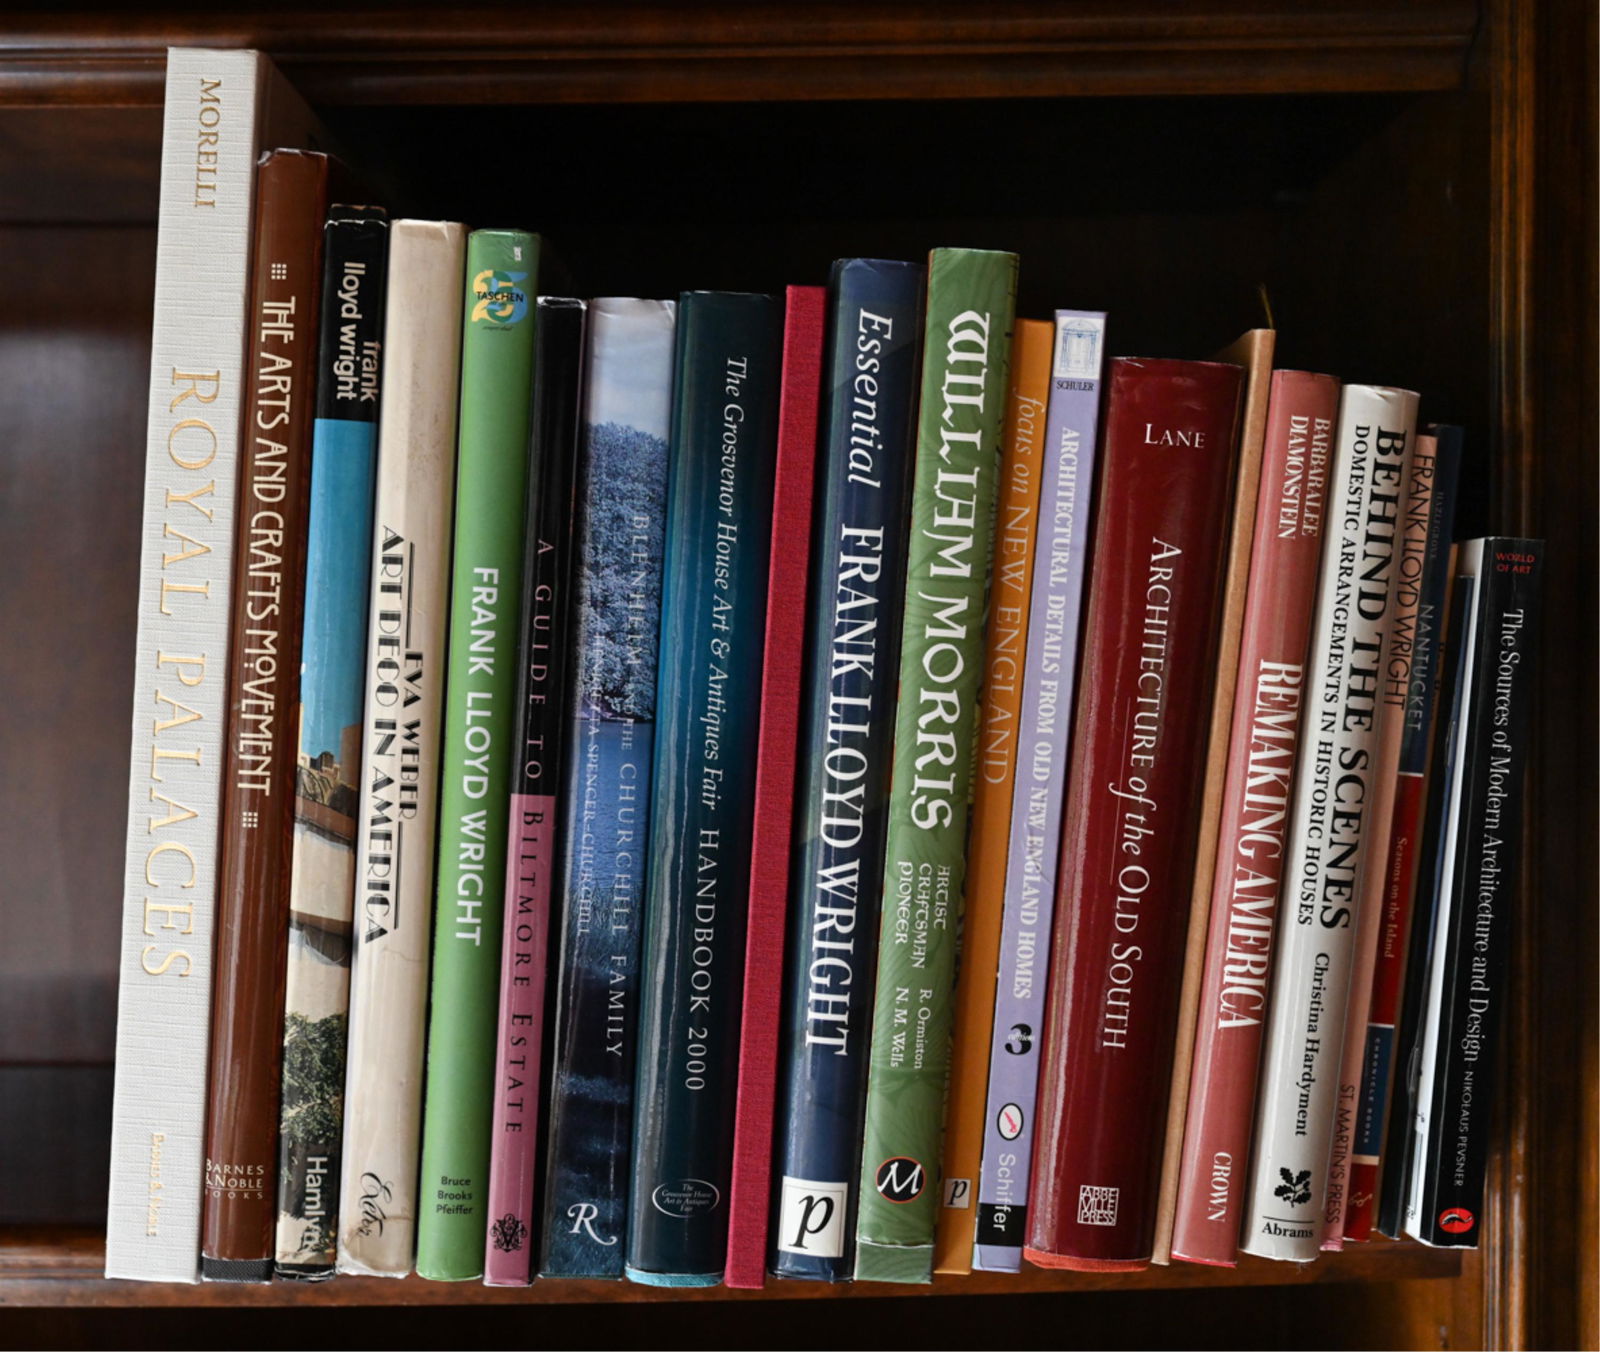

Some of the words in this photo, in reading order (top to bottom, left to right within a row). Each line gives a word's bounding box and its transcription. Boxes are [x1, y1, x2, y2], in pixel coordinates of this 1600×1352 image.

[193, 78, 222, 208] MORELLI
[260, 296, 296, 344] THE
[338, 260, 366, 320] lloyd
[477, 291, 524, 302] TASCHEN
[256, 353, 294, 426] ARTS
[333, 323, 361, 401] wright
[359, 340, 380, 402] frank
[725, 357, 747, 397] The
[848, 308, 892, 488] Essential
[1056, 380, 1095, 391] SCHULER
[719, 403, 745, 517] Grosvenor
[921, 310, 990, 578] WILLIAM
[1015, 391, 1045, 456] focus
[1144, 423, 1205, 449] LANE
[159, 366, 221, 616] ROYAL
[253, 438, 289, 503] AND
[1012, 463, 1030, 494] on
[1049, 427, 1080, 588] ARCHITECTURAL
[1278, 416, 1309, 539] DIAMONSTEIN
[1302, 418, 1330, 536] BARBARALEE
[1344, 425, 1370, 531] DOMESTIC
[1405, 454, 1435, 533] FRANK
[538, 539, 554, 554] A
[714, 521, 738, 590] House
[1001, 505, 1030, 592] NEW
[1357, 425, 1407, 622] BEHIND
[1495, 552, 1535, 564] WORLD
[247, 507, 284, 622] CRAFTS
[381, 525, 404, 600] ART
[627, 515, 650, 665] BLENHEIM
[1397, 537, 1424, 608] LLOYD
[1496, 563, 1510, 573] OF
[1512, 565, 1532, 575] ART
[468, 567, 499, 676] FRANK
[711, 594, 733, 632] Art
[831, 523, 884, 680] FRANK
[1041, 594, 1067, 674] DETAILS
[1324, 537, 1356, 704] ARRANGEMENTS
[1501, 609, 1524, 647] The
[375, 609, 401, 708] DECO
[403, 651, 423, 709] EVA
[529, 584, 553, 704] GUIDE
[710, 637, 731, 659] &
[1130, 536, 1182, 768] ARCHITECTURE
[1384, 614, 1417, 711] WRIGHT
[1407, 604, 1434, 731] NANTUCKET
[236, 623, 280, 796] MOVEMENT
[700, 663, 729, 760] Antiques
[911, 591, 969, 830] MORRIS
[983, 606, 1021, 784] ENGLAND
[1036, 679, 1058, 735] FROM
[1342, 632, 1383, 732] THE
[1493, 650, 1521, 726] Sources
[372, 718, 397, 757] IN
[462, 691, 493, 800] LLOYD
[525, 734, 543, 779] TO
[1237, 658, 1302, 860] REMAKING
[1320, 711, 1337, 734] IN
[1492, 731, 1513, 752] of
[398, 718, 421, 820] WEBER
[702, 765, 724, 810] Fair
[820, 692, 872, 848] LLOYD
[1032, 741, 1052, 782] OLD
[1108, 776, 1157, 811] of
[1308, 740, 1333, 839] HISTORIC
[1485, 755, 1511, 829] Modern
[141, 652, 208, 978] PALACES
[577, 744, 599, 937] SPENCER-CHURCHILL
[1028, 787, 1049, 830] NEW
[1122, 813, 1154, 856] the
[1320, 746, 1369, 930] SCENES
[365, 766, 394, 944] AMERICA
[455, 808, 488, 947] WRIGHT
[612, 763, 637, 936] CHURCHILL
[1020, 835, 1045, 926] ENGLAND
[1298, 847, 1320, 926] HOUSES
[513, 809, 544, 988] BILTMORE
[688, 828, 720, 1013] HANDBOOK
[895, 860, 913, 945] PIONEER
[912, 862, 932, 969] CRAFTSMAN
[1114, 864, 1150, 934] OLD
[1388, 902, 1400, 920] the
[1391, 884, 1400, 899] on
[1474, 834, 1504, 952] Architecture
[805, 858, 860, 1056] WRIGHT
[1013, 931, 1036, 999] HOMES
[1218, 863, 1278, 1030] AMERICA
[1470, 957, 1490, 992] and
[605, 955, 628, 1057] FAMILY
[894, 1008, 908, 1027] M.
[896, 986, 909, 1004] N.
[919, 988, 932, 1003] R.
[1103, 943, 1142, 1049] SOUTH
[1307, 952, 1330, 1034] Christina
[1461, 999, 1489, 1062] Design
[505, 1013, 532, 1133] ESTATE
[685, 1026, 709, 1091] 2000
[890, 1031, 906, 1068] Wells
[914, 1007, 931, 1069] Ormiston
[1295, 1037, 1320, 1137] Hardyment
[1340, 1084, 1355, 1104] ST.
[1457, 1070, 1474, 1133] NIKOLAUS
[206, 1158, 265, 1175] BARNES
[215, 1174, 264, 1189] NOBLE
[441, 1176, 471, 1186] Bruce
[1329, 1109, 1351, 1180] MARTIN'S
[1453, 1136, 1468, 1187] PEVSNER
[303, 1156, 328, 1246] Hamlyn
[436, 1204, 474, 1215] Pfeiffer
[437, 1190, 473, 1201] Brooks
[567, 1204, 618, 1246] R
[993, 1153, 1016, 1232] Schiffer
[1207, 1152, 1232, 1223] CROWN
[1326, 1184, 1343, 1224] PRESS
[1262, 1222, 1314, 1239] Abrams
